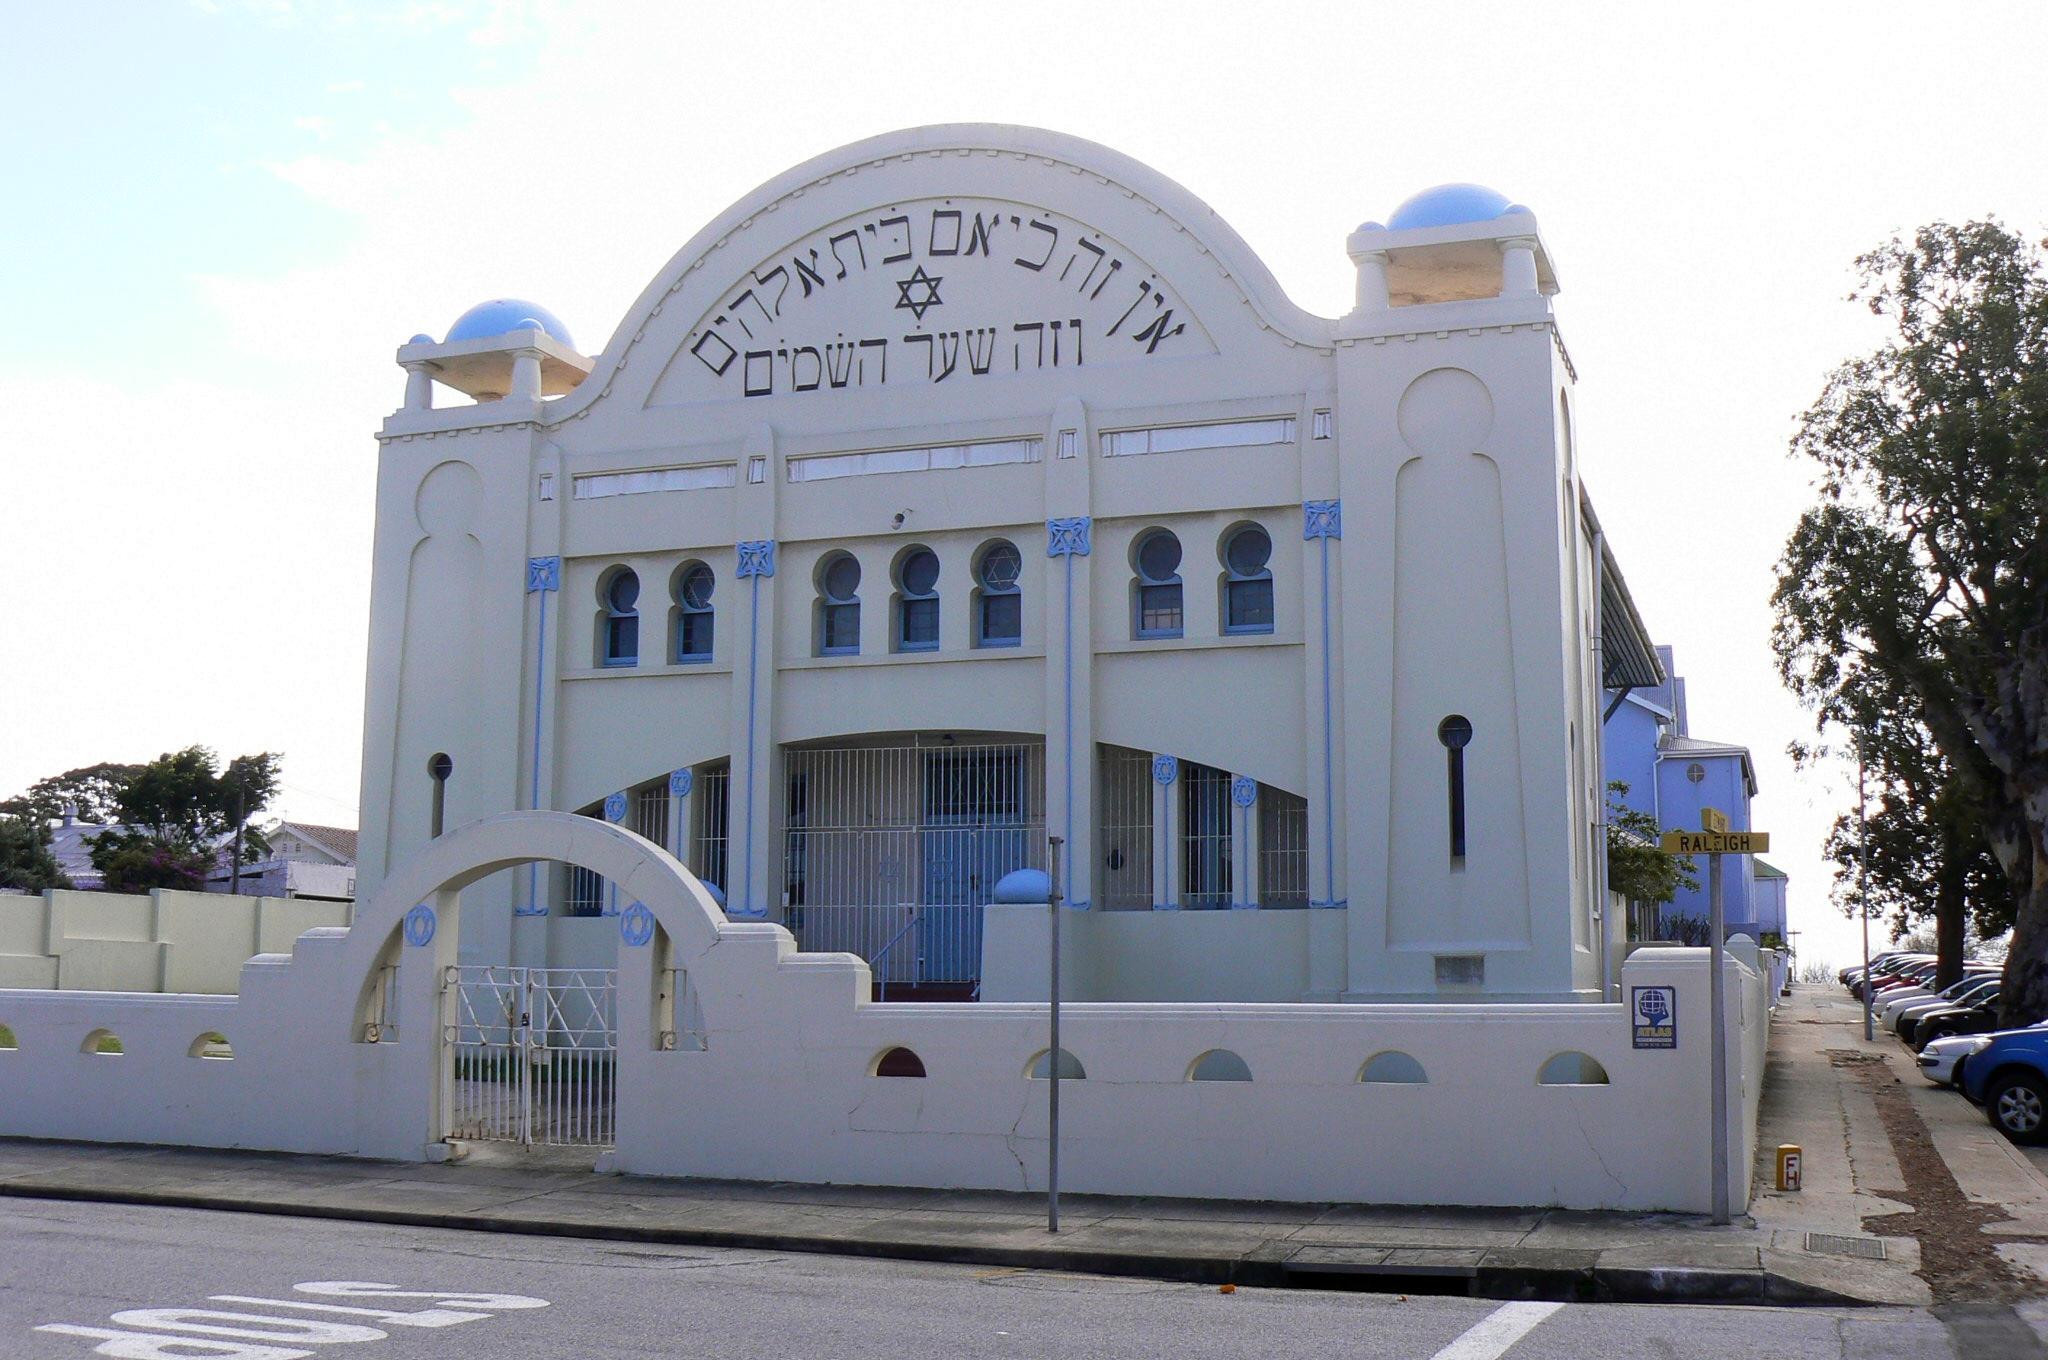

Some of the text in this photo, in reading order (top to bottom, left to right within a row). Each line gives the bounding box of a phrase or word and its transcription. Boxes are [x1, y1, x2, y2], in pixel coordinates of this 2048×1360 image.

[929, 209, 1000, 257] אם
[1010, 214, 1058, 272] כי
[1060, 237, 1122, 300] זה
[1105, 280, 1186, 354] אין
[744, 319, 1082, 397] וזה שער השמים
[1680, 835, 1750, 852] RALEIGH
[33, 1281, 551, 1360] STOP
